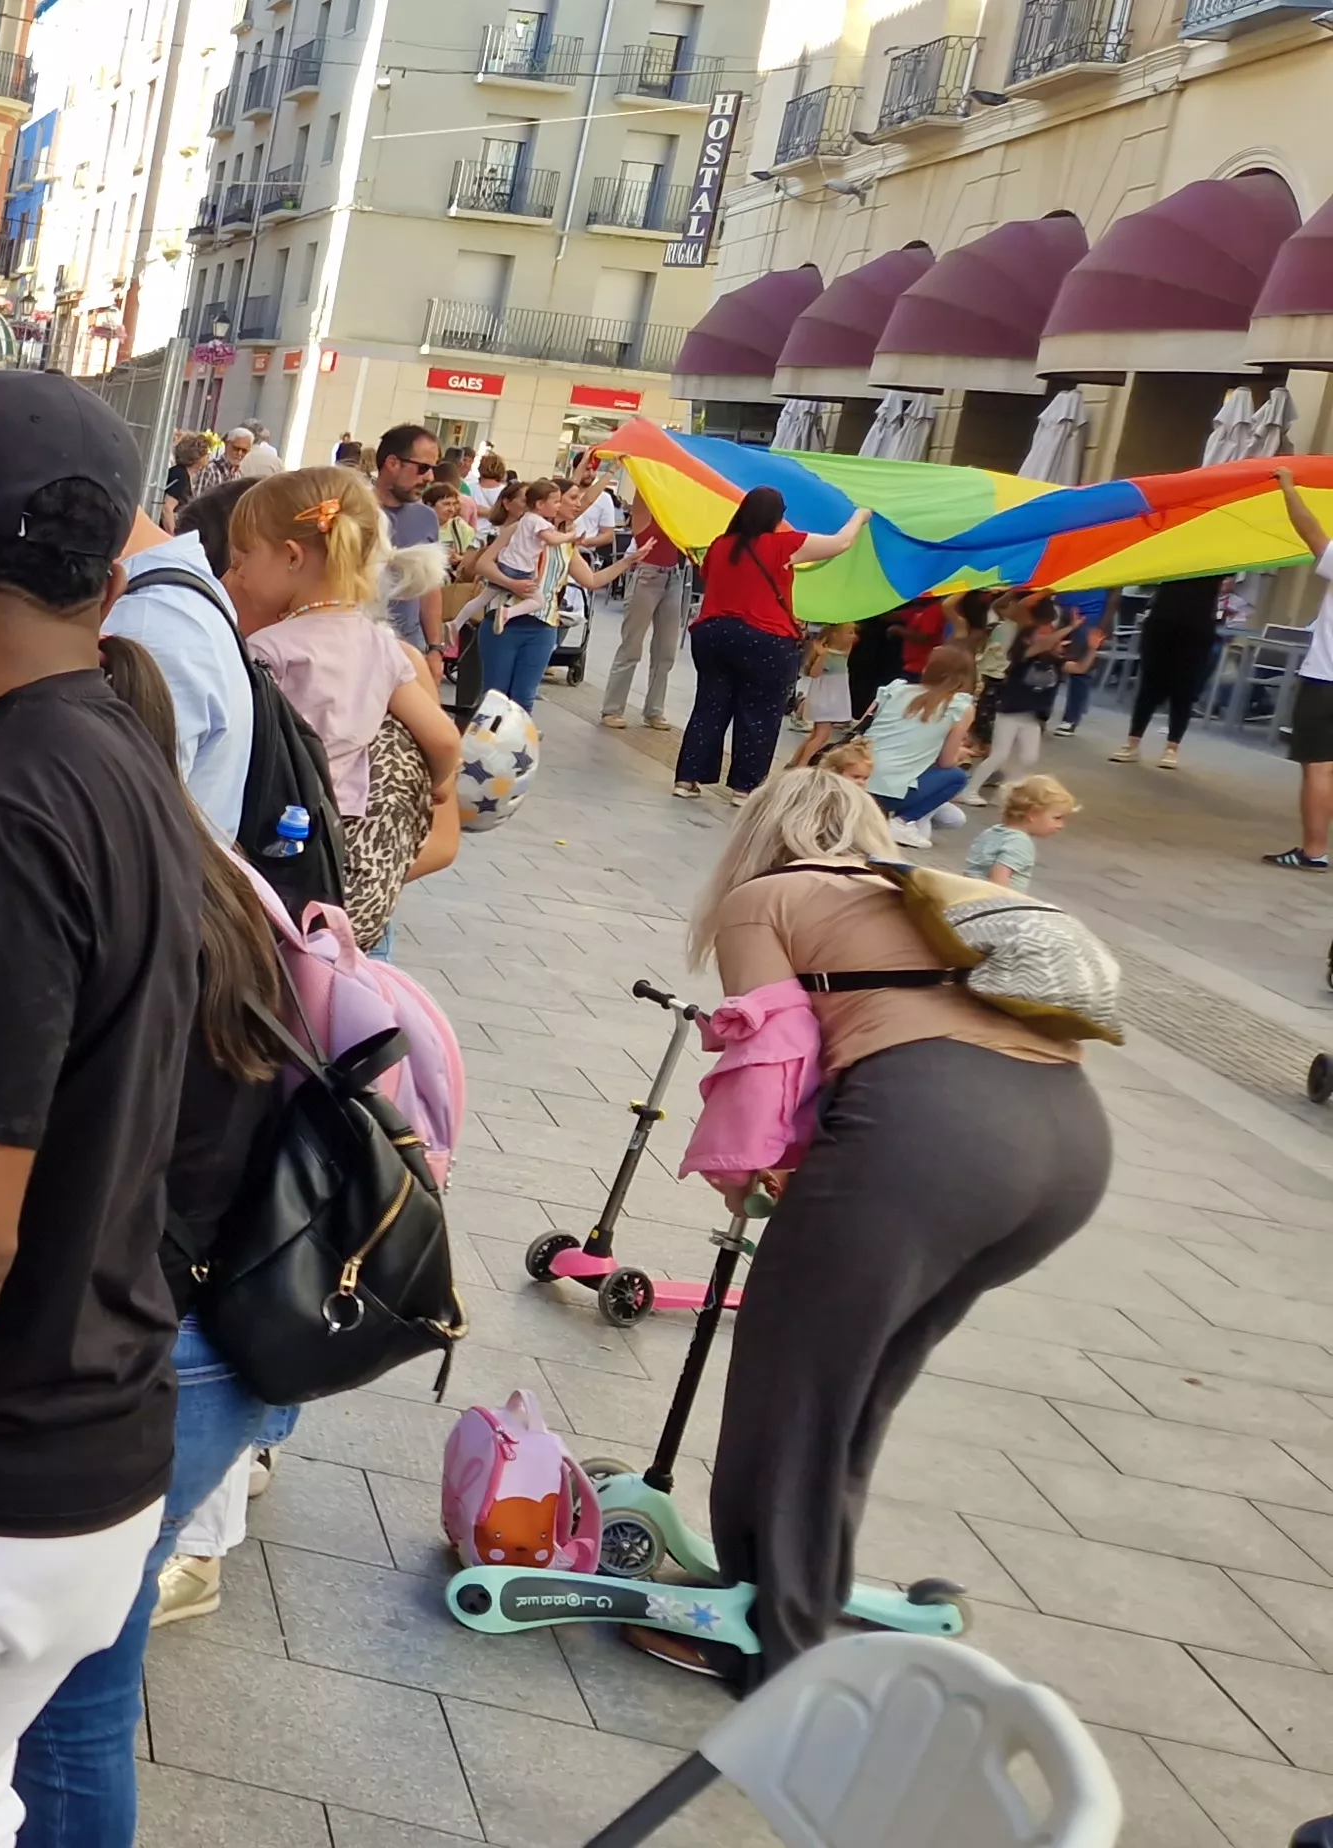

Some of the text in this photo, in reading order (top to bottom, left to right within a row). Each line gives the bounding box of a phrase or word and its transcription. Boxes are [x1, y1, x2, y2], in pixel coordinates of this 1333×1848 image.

[687, 93, 737, 237] HOSTAL
[664, 242, 703, 265] RUGACA
[448, 375, 483, 391] GAES
[516, 1592, 613, 1609] GLOBBER
